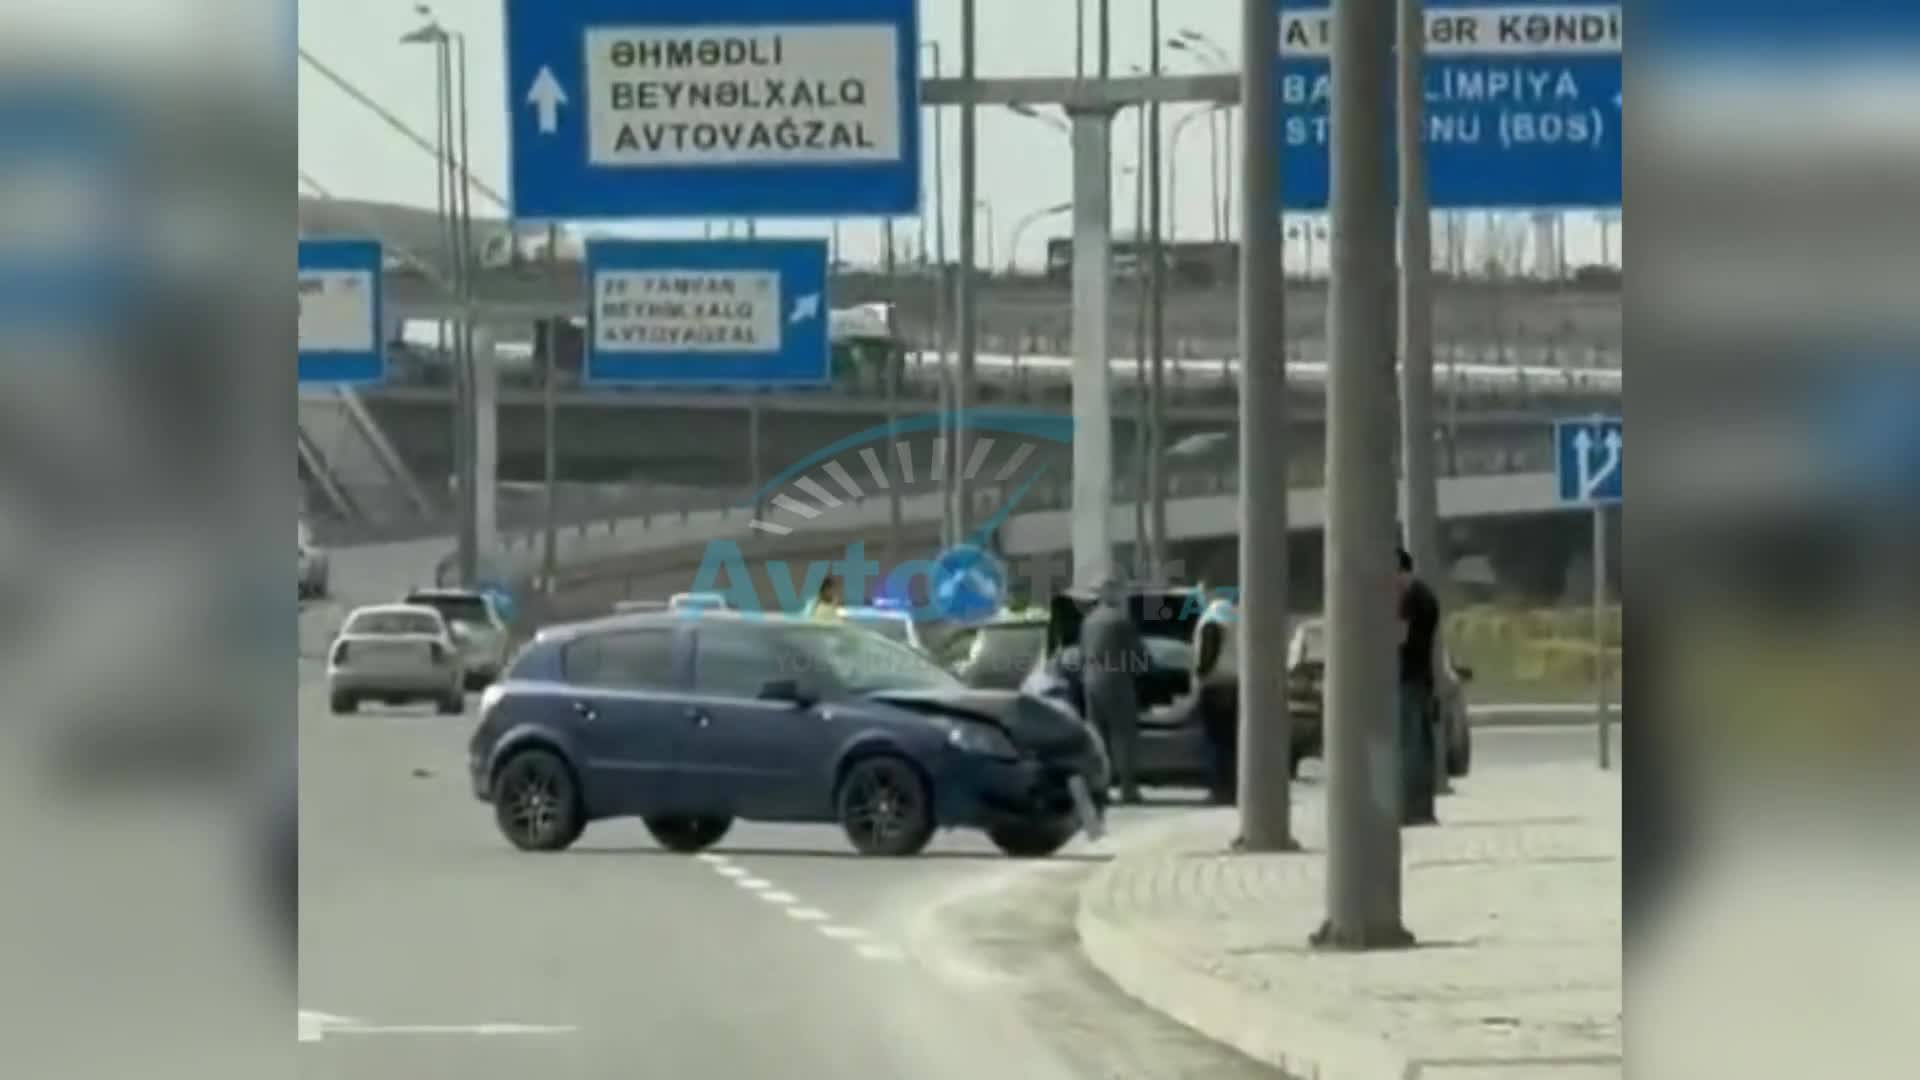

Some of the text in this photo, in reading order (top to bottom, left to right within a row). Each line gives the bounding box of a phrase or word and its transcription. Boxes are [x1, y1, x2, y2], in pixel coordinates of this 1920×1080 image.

[1499, 12, 1618, 44] KƏNDİ
[610, 34, 783, 68] ƏHMƏDLİ
[611, 77, 867, 111] BEYNƏLXALQ
[1423, 67, 1579, 101] LİMPİYA
[614, 115, 876, 151] AVTOVAĞZAL
[1499, 107, 1604, 149] (BOS)
